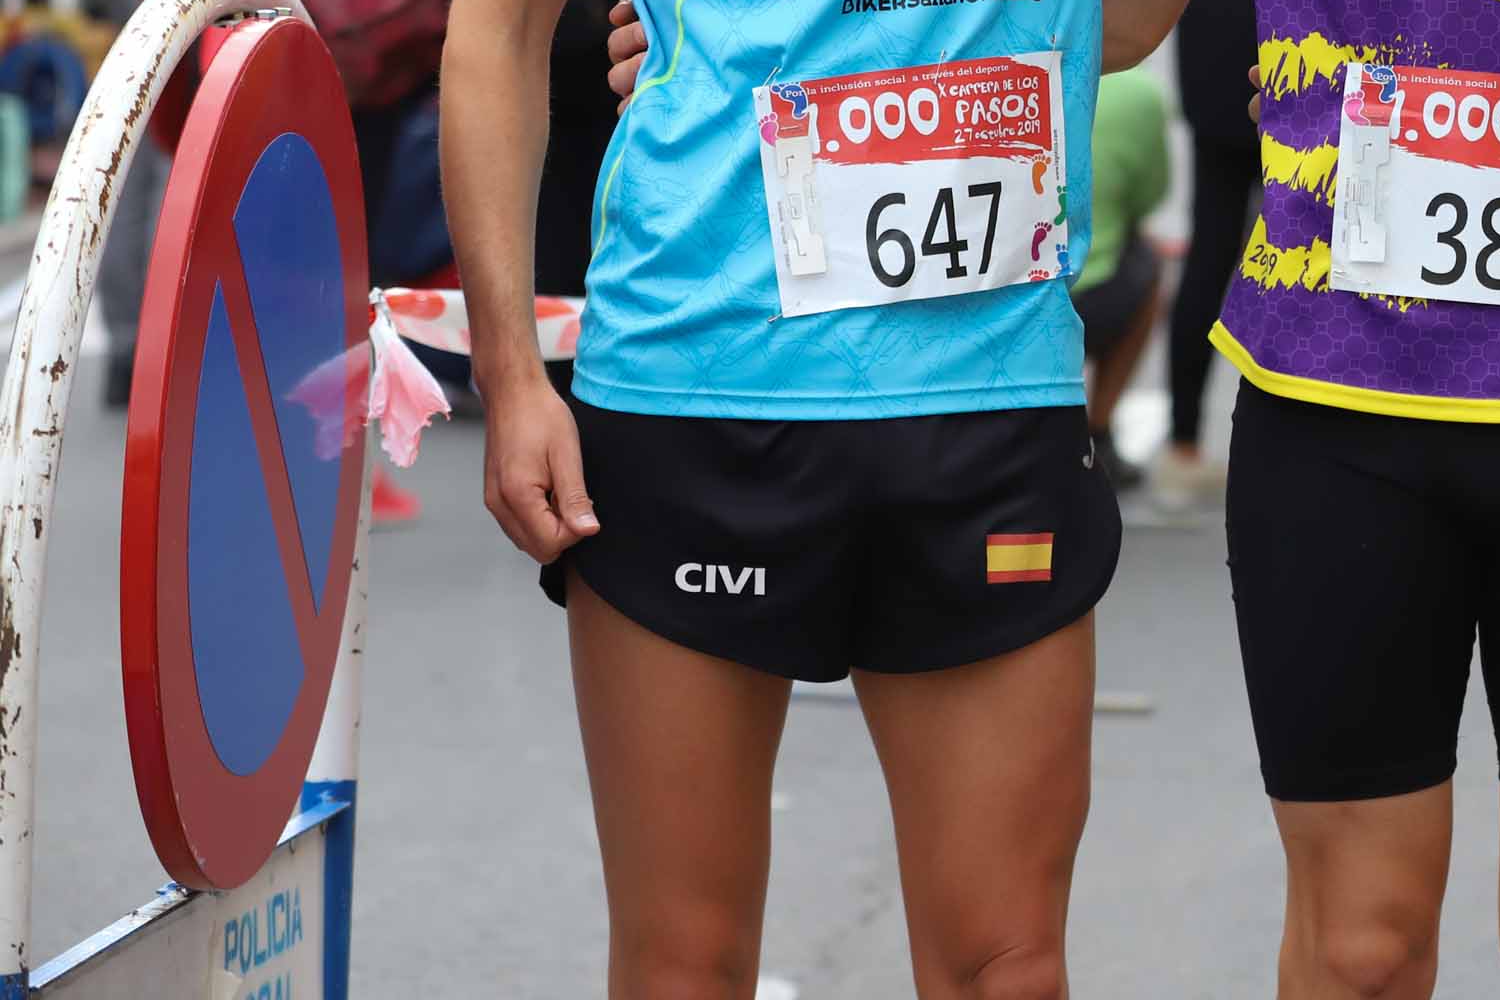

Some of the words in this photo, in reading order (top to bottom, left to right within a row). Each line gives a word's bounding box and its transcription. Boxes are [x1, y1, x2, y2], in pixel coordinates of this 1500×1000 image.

[806, 87, 816, 96] la
[820, 79, 872, 94] inclusión
[874, 75, 906, 86] social
[957, 66, 973, 76] del
[975, 64, 1009, 75] deporte
[1002, 78, 1013, 91] DE
[1017, 76, 1039, 90] LOS
[1397, 74, 1407, 82] la
[1411, 74, 1462, 86] inclusión
[1465, 79, 1497, 89] social
[955, 92, 1040, 125] PASOS
[954, 128, 973, 143] 27
[975, 122, 1016, 140] octubre
[1018, 120, 1041, 136] 2019
[866, 181, 1003, 288] 647
[674, 562, 767, 596] CIVI
